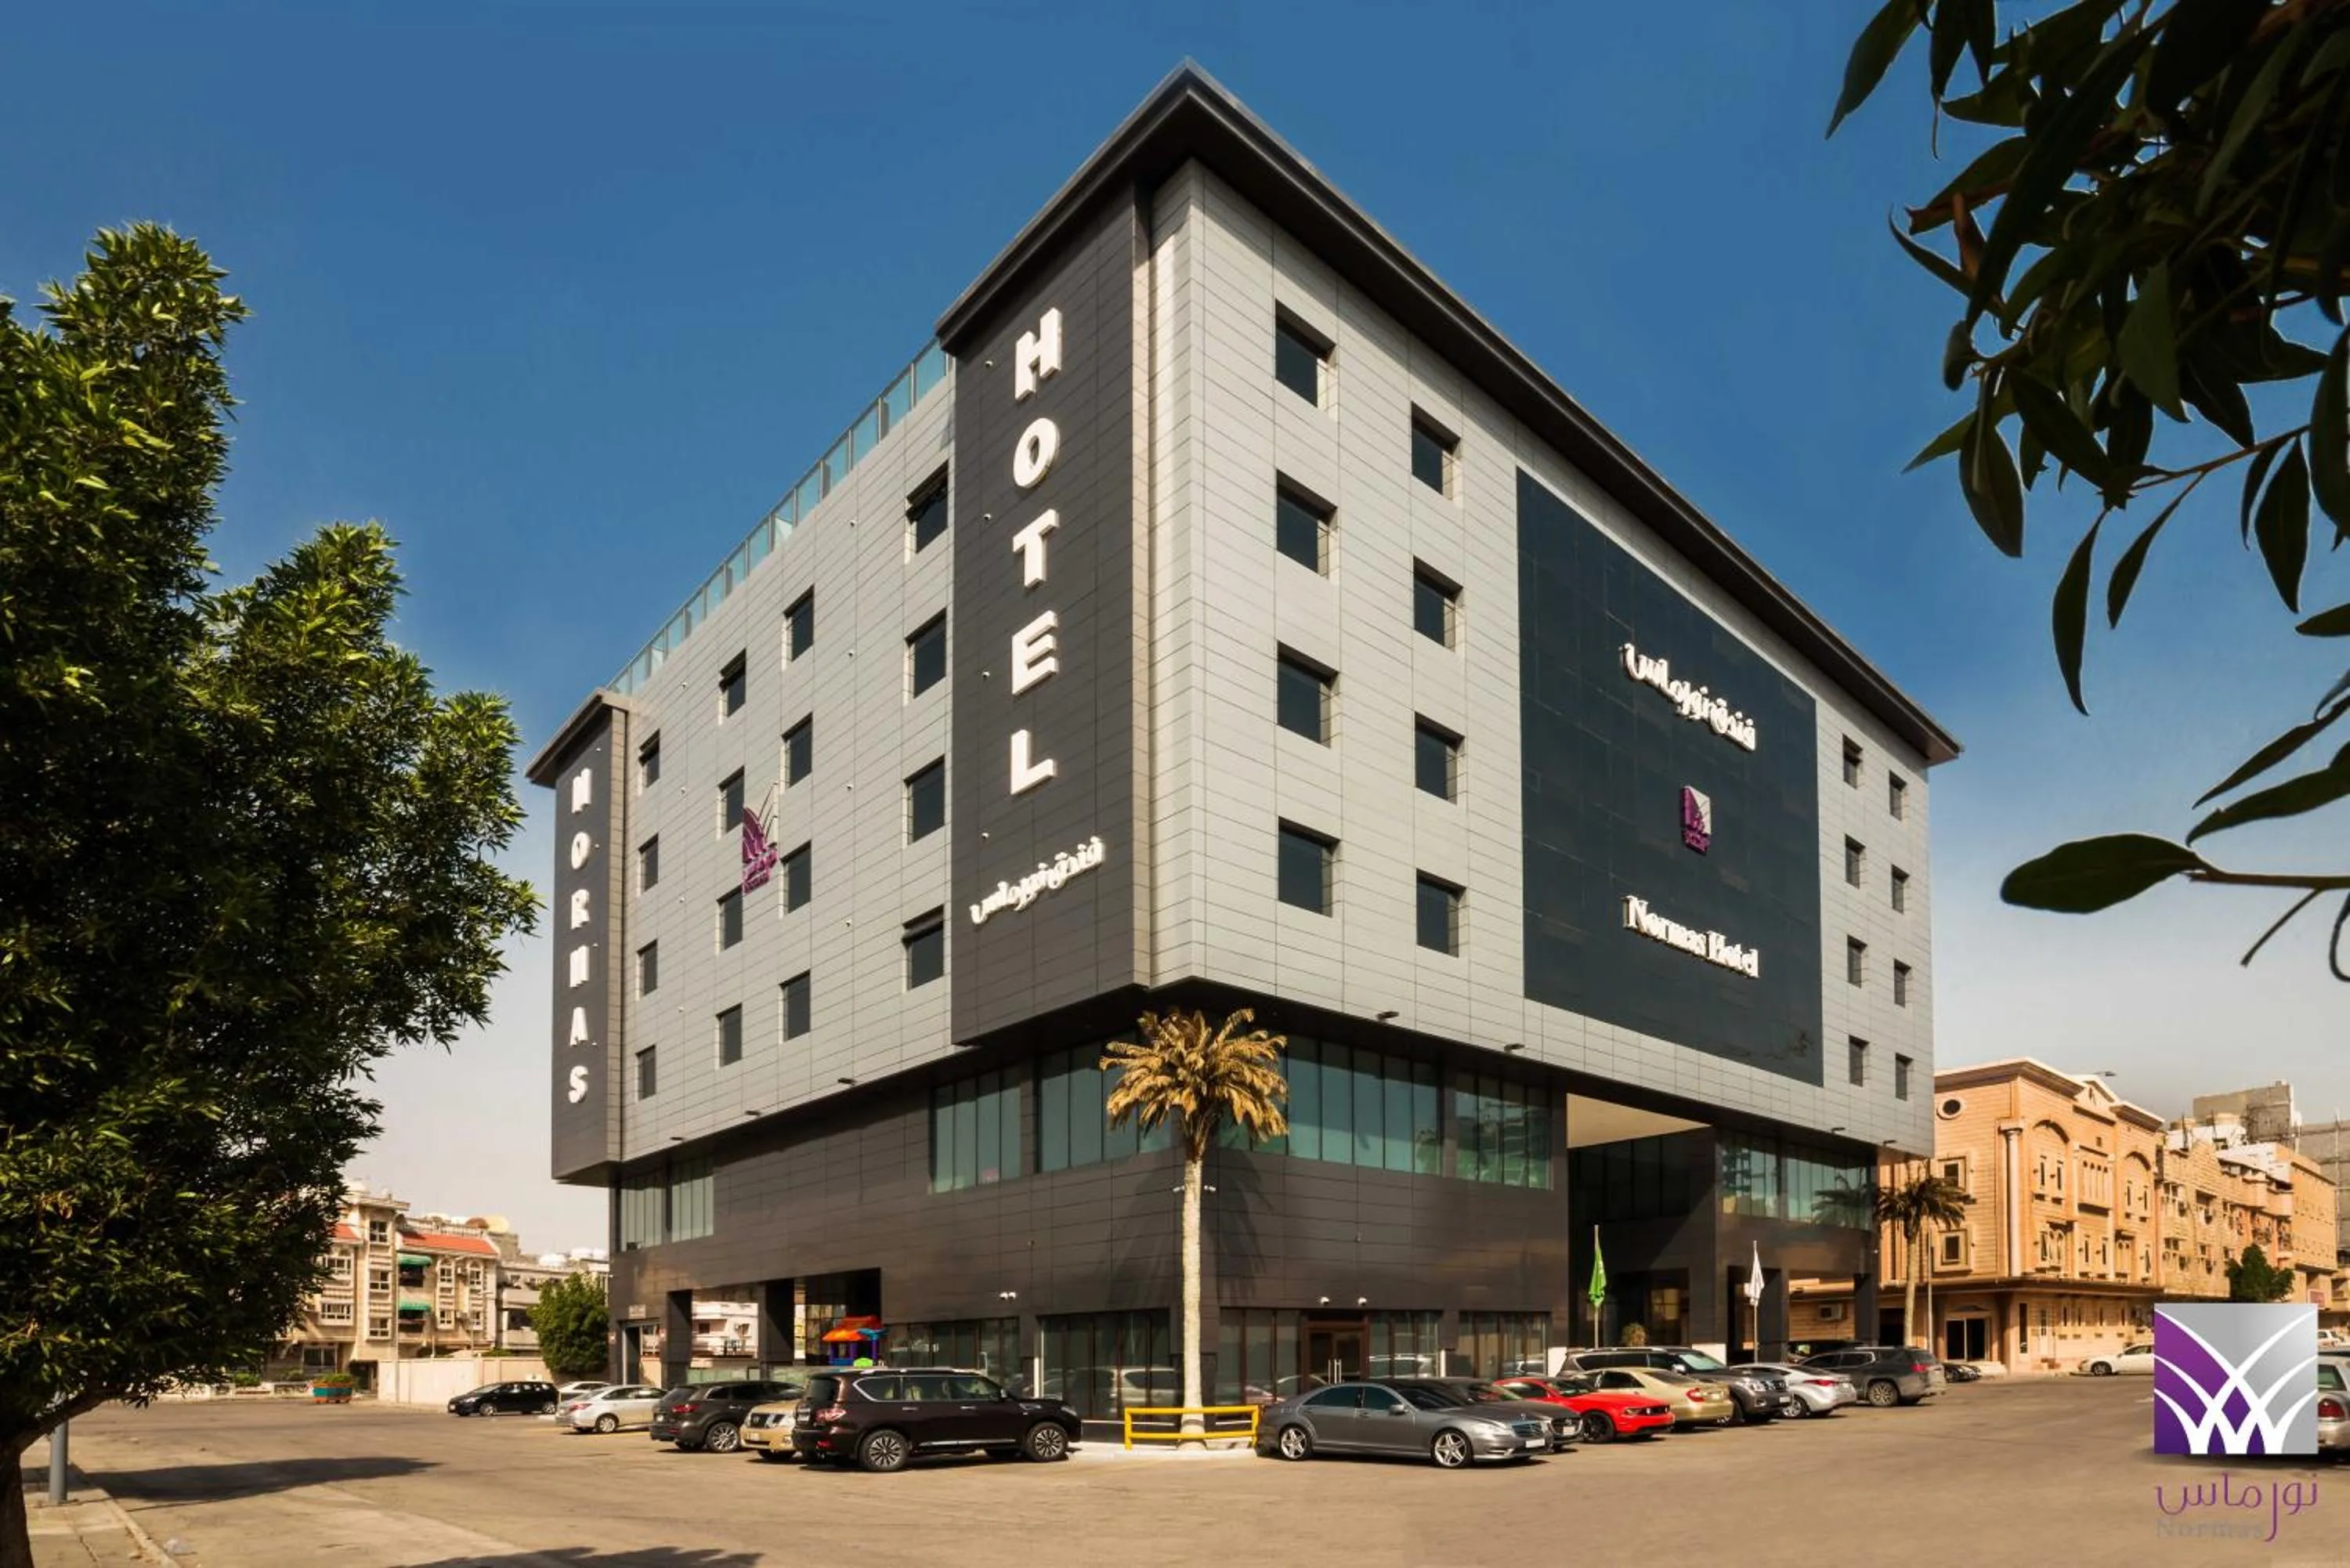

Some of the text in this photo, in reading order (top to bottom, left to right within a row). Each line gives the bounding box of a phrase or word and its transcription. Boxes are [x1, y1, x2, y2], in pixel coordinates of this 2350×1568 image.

[1010, 307, 1062, 795] HOTEL
[569, 768, 592, 1104] NORMAS
[1622, 894, 1759, 978] Normas Hotel
